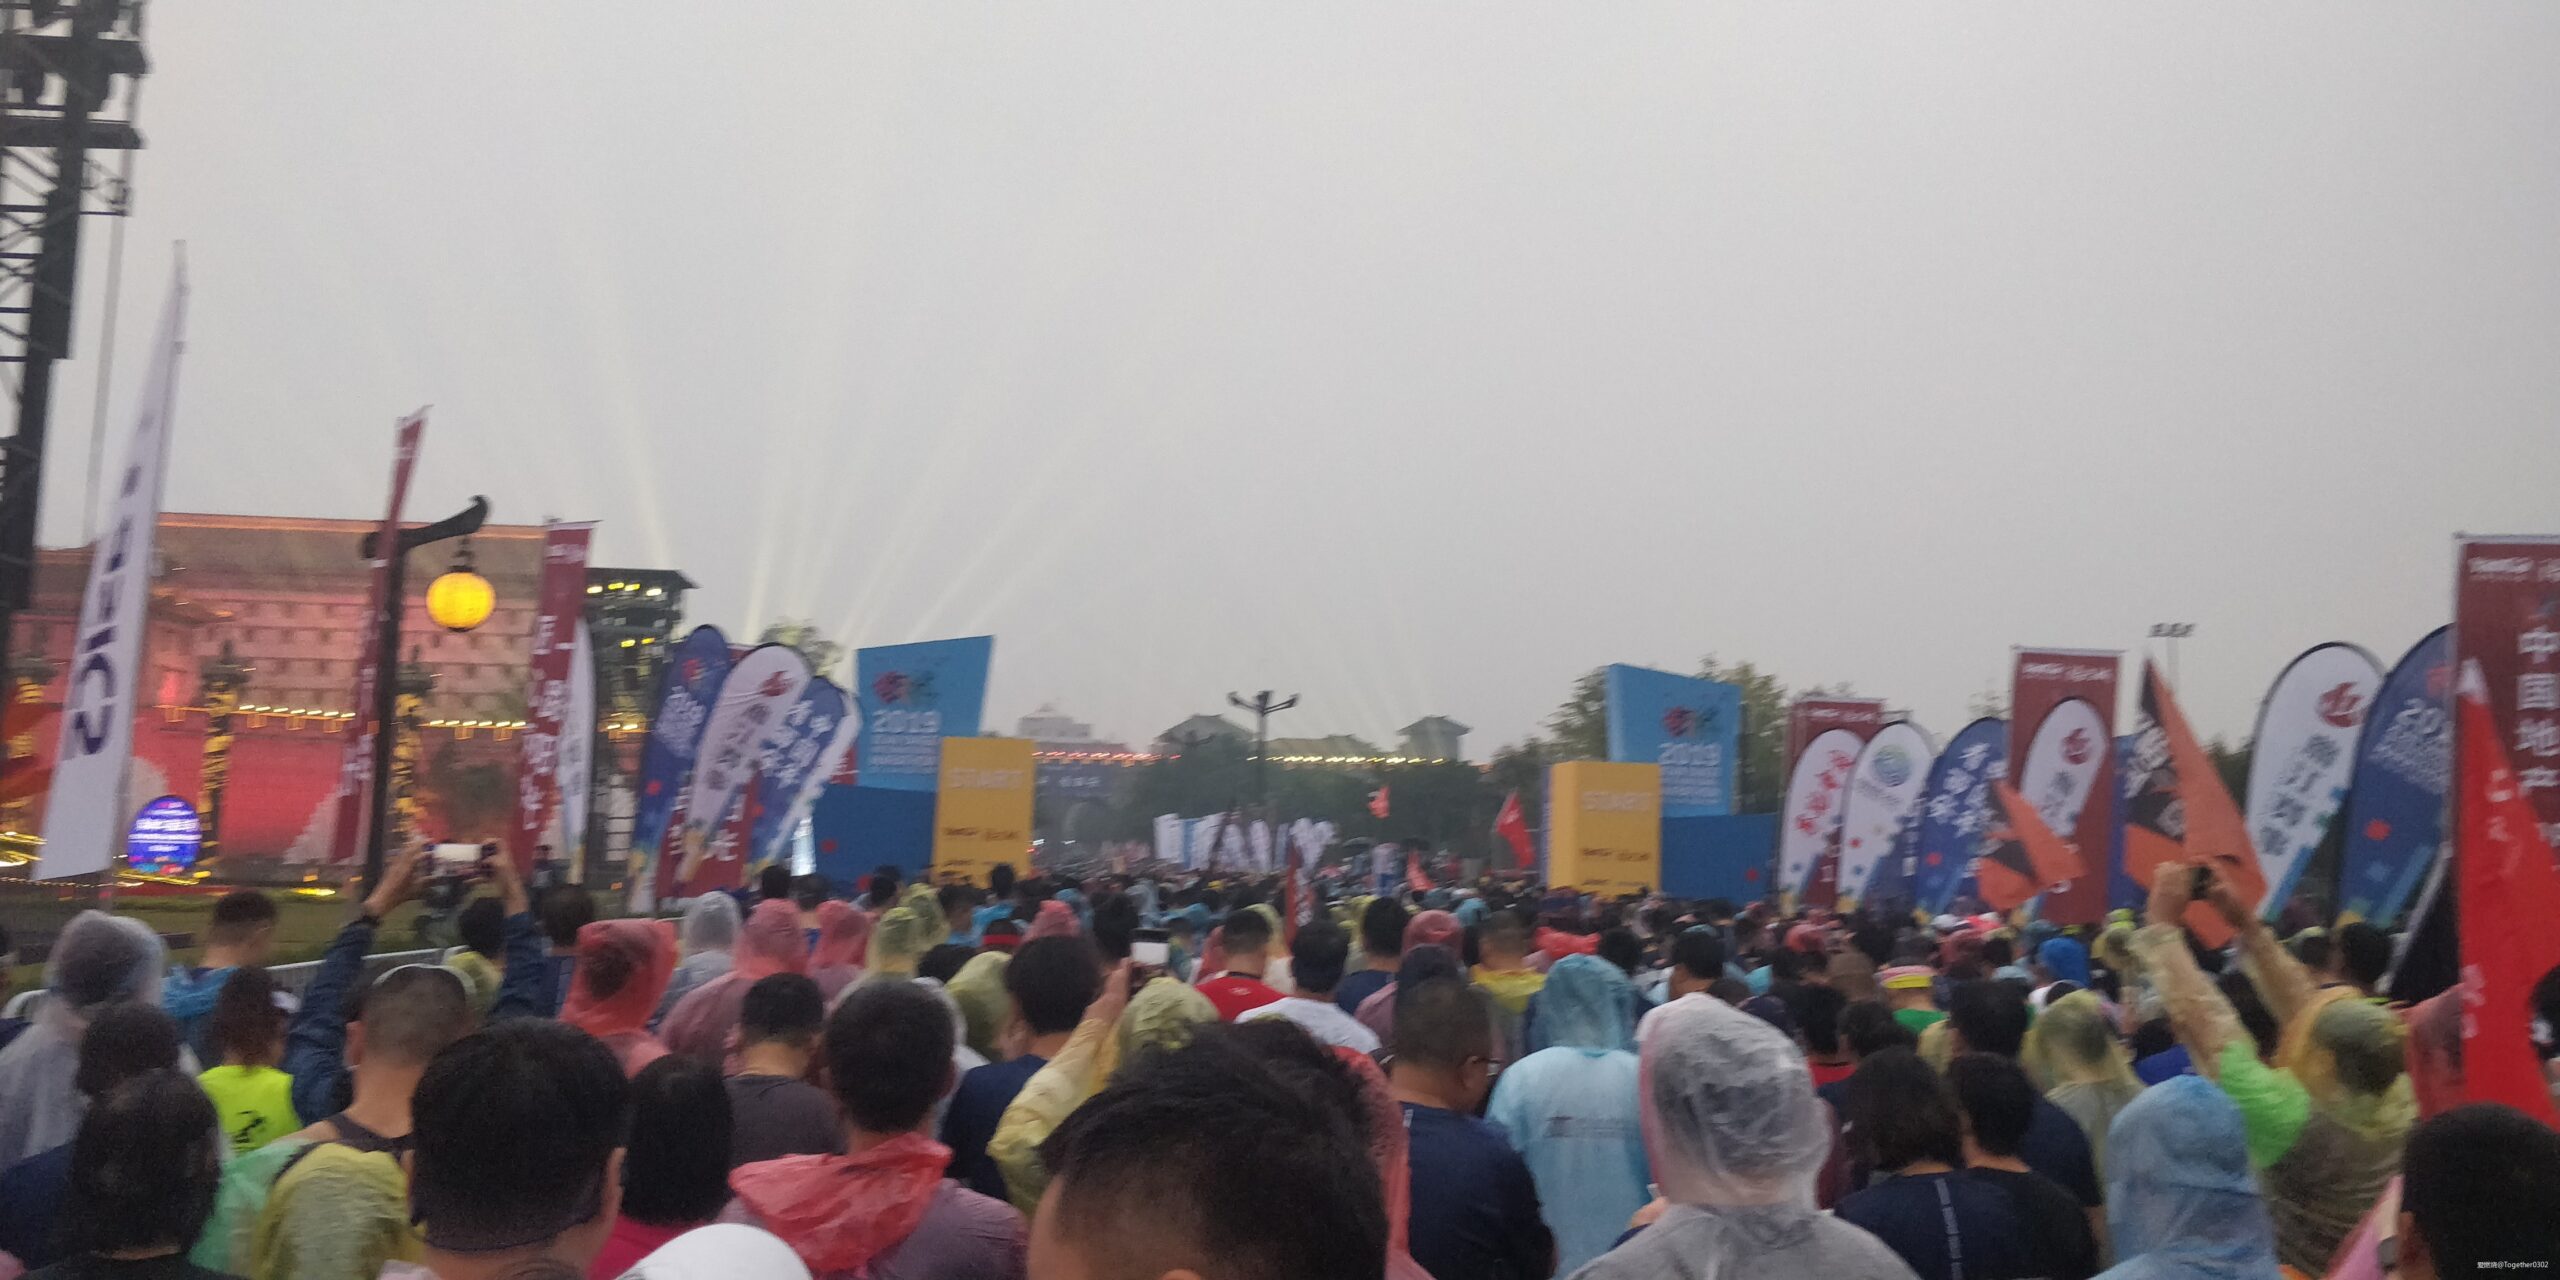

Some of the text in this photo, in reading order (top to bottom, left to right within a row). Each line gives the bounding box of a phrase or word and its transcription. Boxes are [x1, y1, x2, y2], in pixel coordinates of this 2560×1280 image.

[872, 709, 940, 734] 2019
[1658, 742, 1722, 766] 2019
[949, 768, 1025, 789] START
